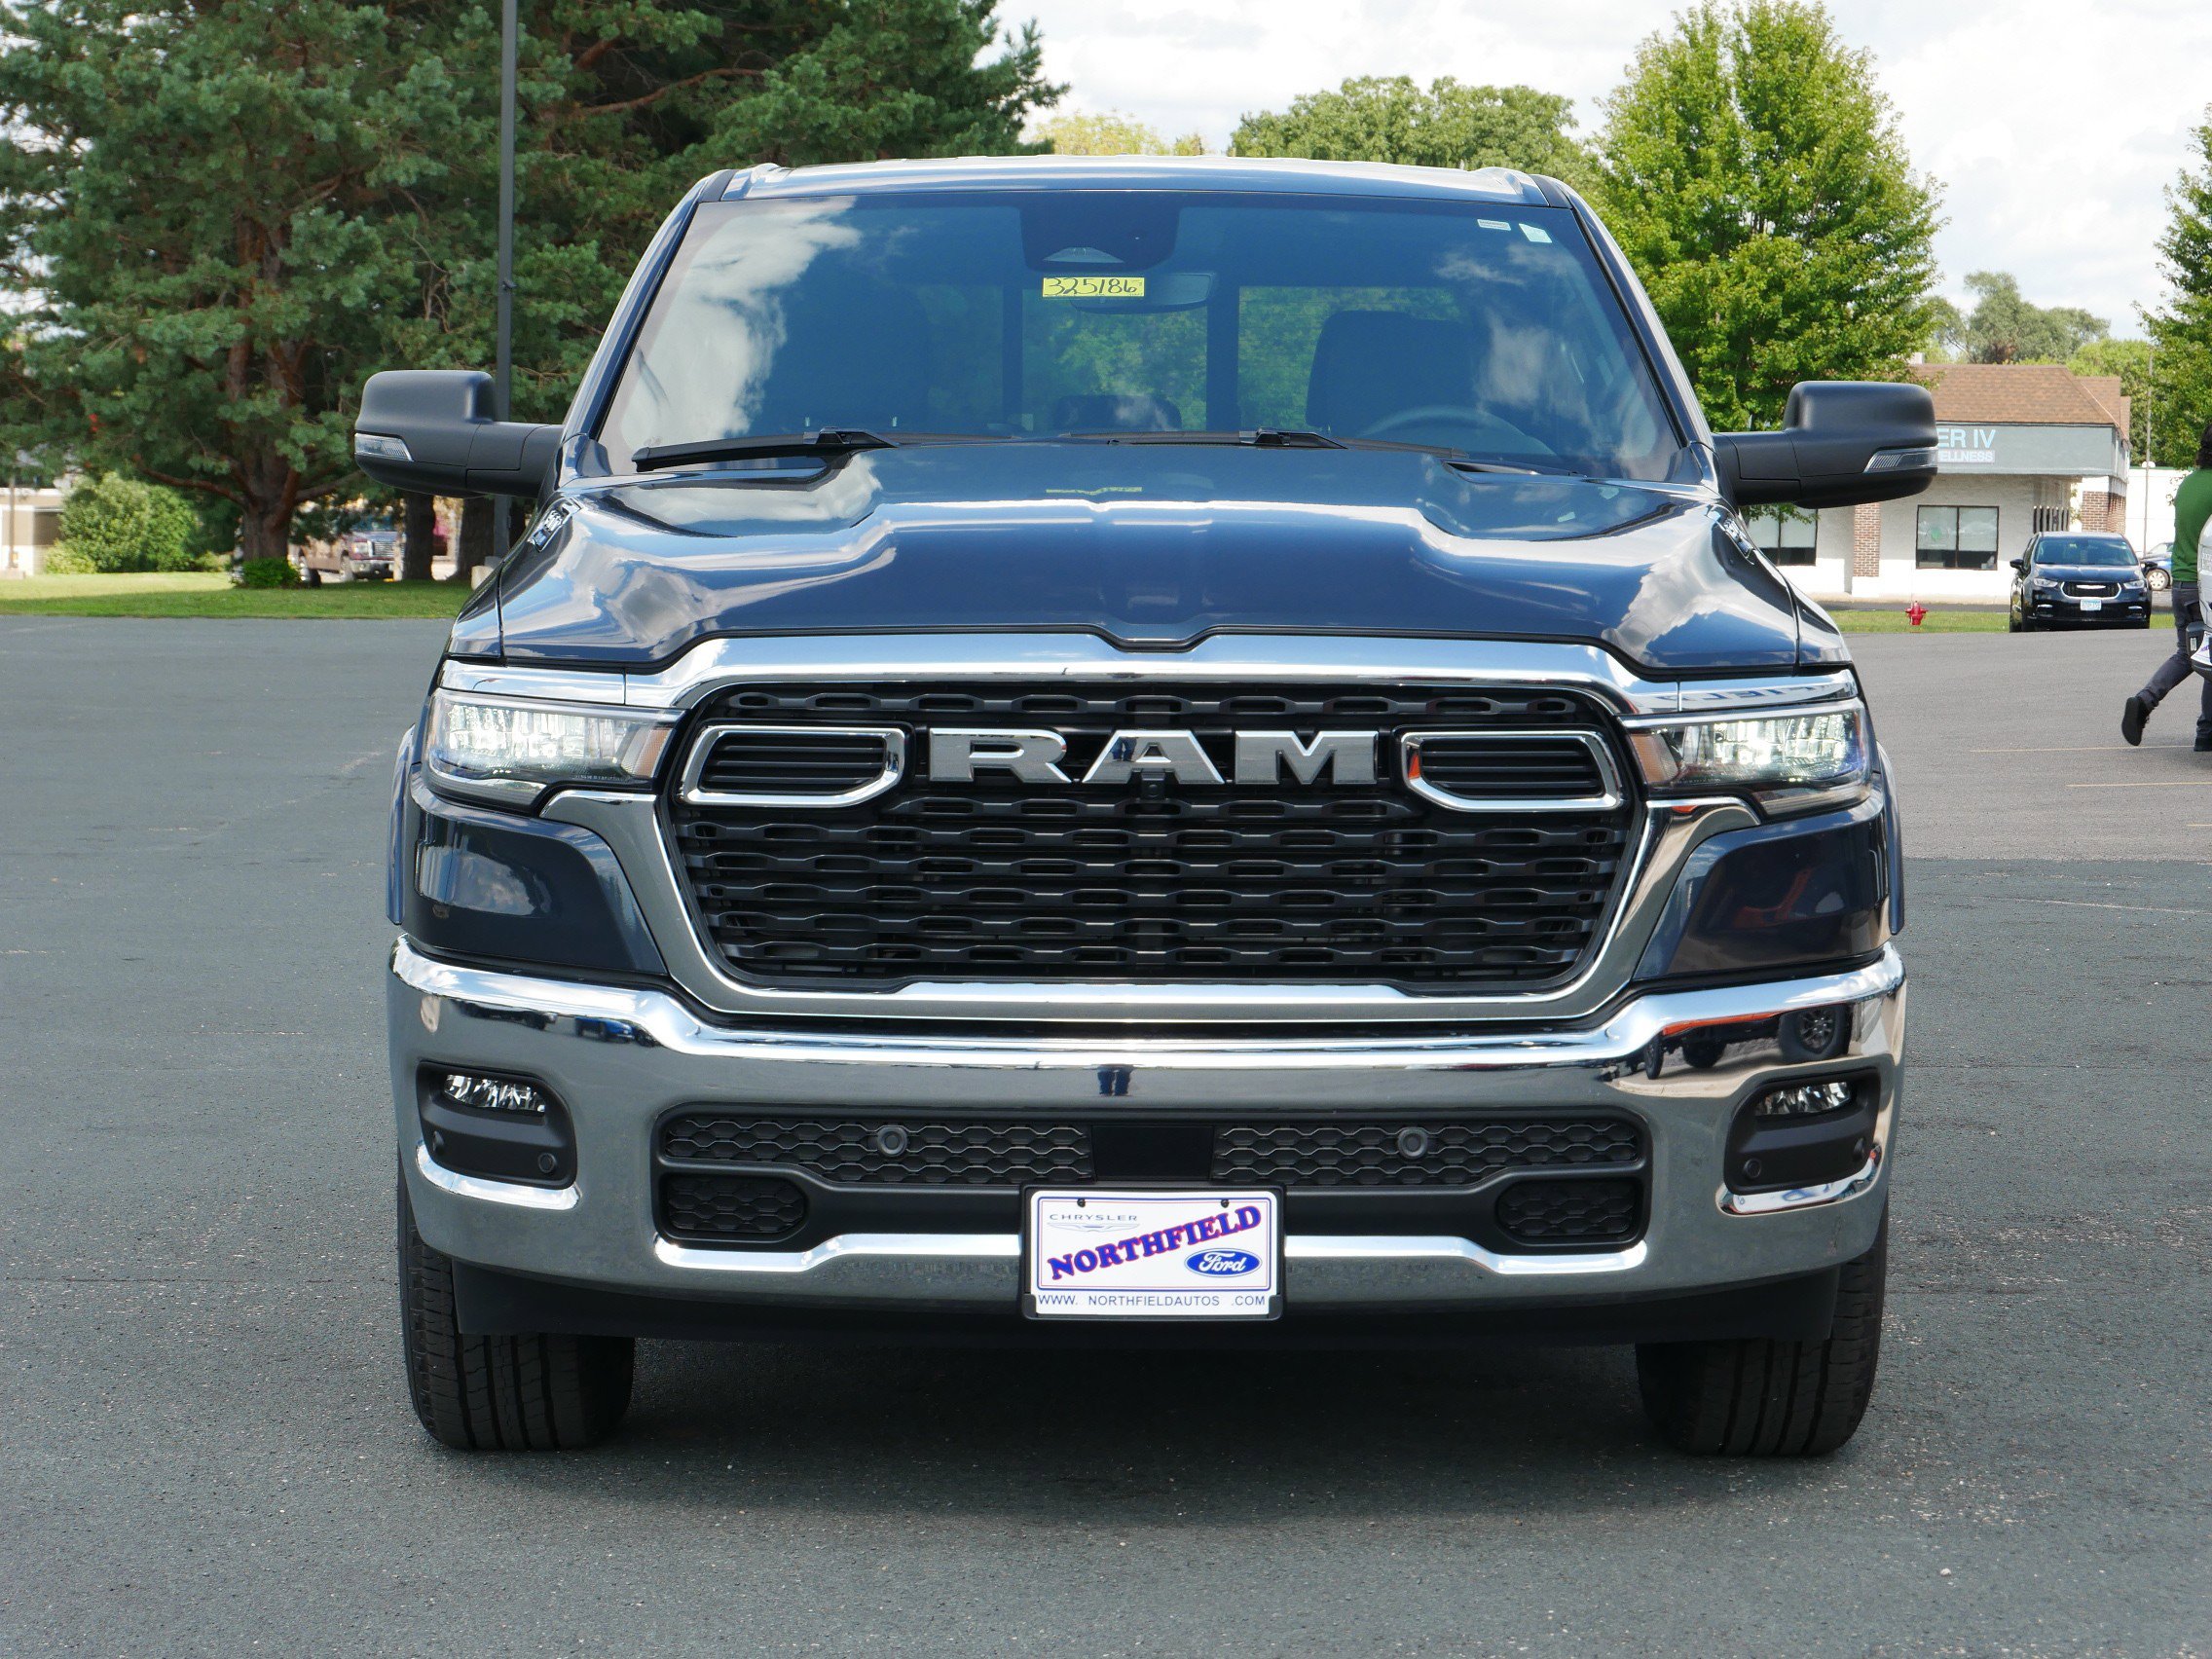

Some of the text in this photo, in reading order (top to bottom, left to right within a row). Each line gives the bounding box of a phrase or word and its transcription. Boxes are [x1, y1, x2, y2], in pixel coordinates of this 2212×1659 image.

[1044, 277, 1139, 296] 325186
[1936, 428, 1996, 448] ER IV
[1937, 450, 1994, 462] ELLNESS
[930, 727, 1379, 785] RAM
[1048, 1205, 1262, 1279] NORTHFIELD
[1198, 1252, 1246, 1272] Ford
[1088, 1295, 1220, 1307] NORTHFIELDAUTOS
